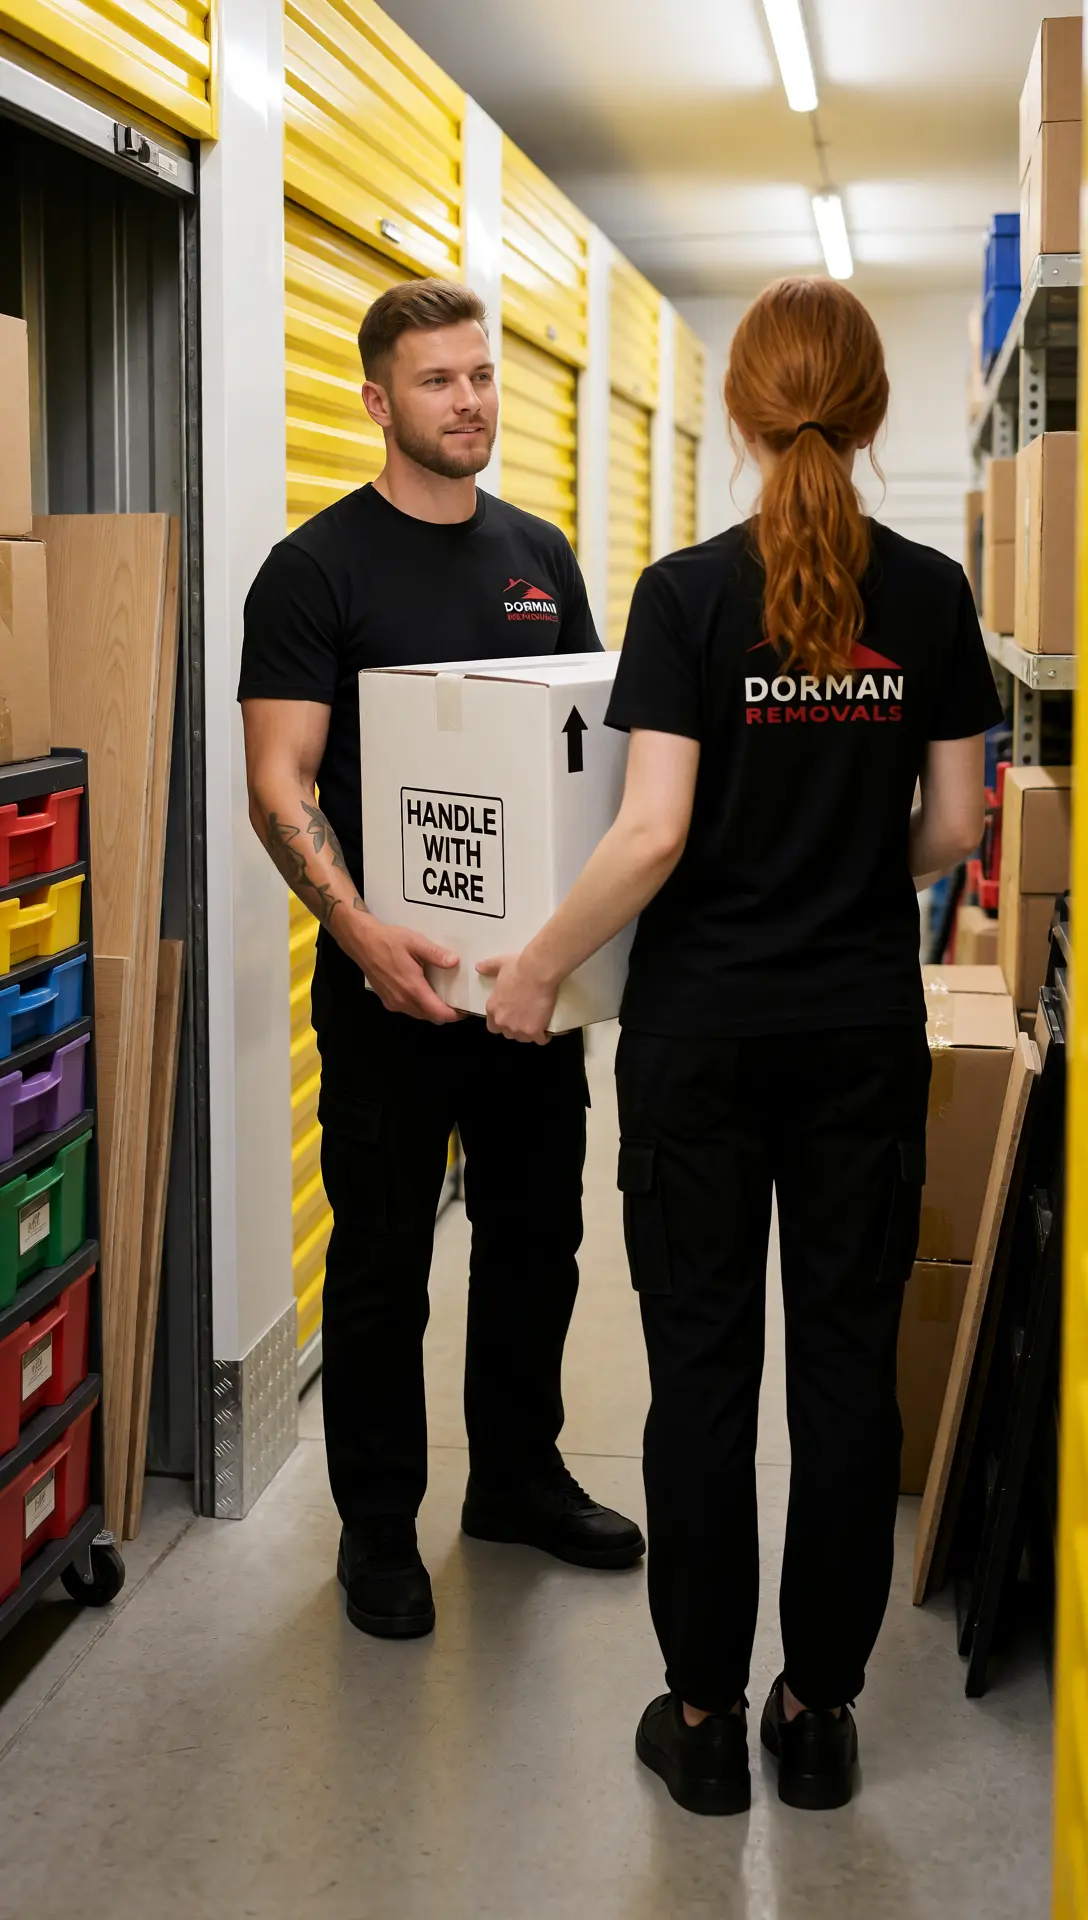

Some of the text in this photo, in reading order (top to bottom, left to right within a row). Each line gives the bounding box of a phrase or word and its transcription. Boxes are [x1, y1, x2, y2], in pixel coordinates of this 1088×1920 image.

[745, 674, 904, 702] DORMAN
[746, 705, 903, 724] REMOVALS
[407, 799, 497, 836] HANDLE
[422, 833, 481, 868] WITH
[422, 867, 484, 903] CARE
